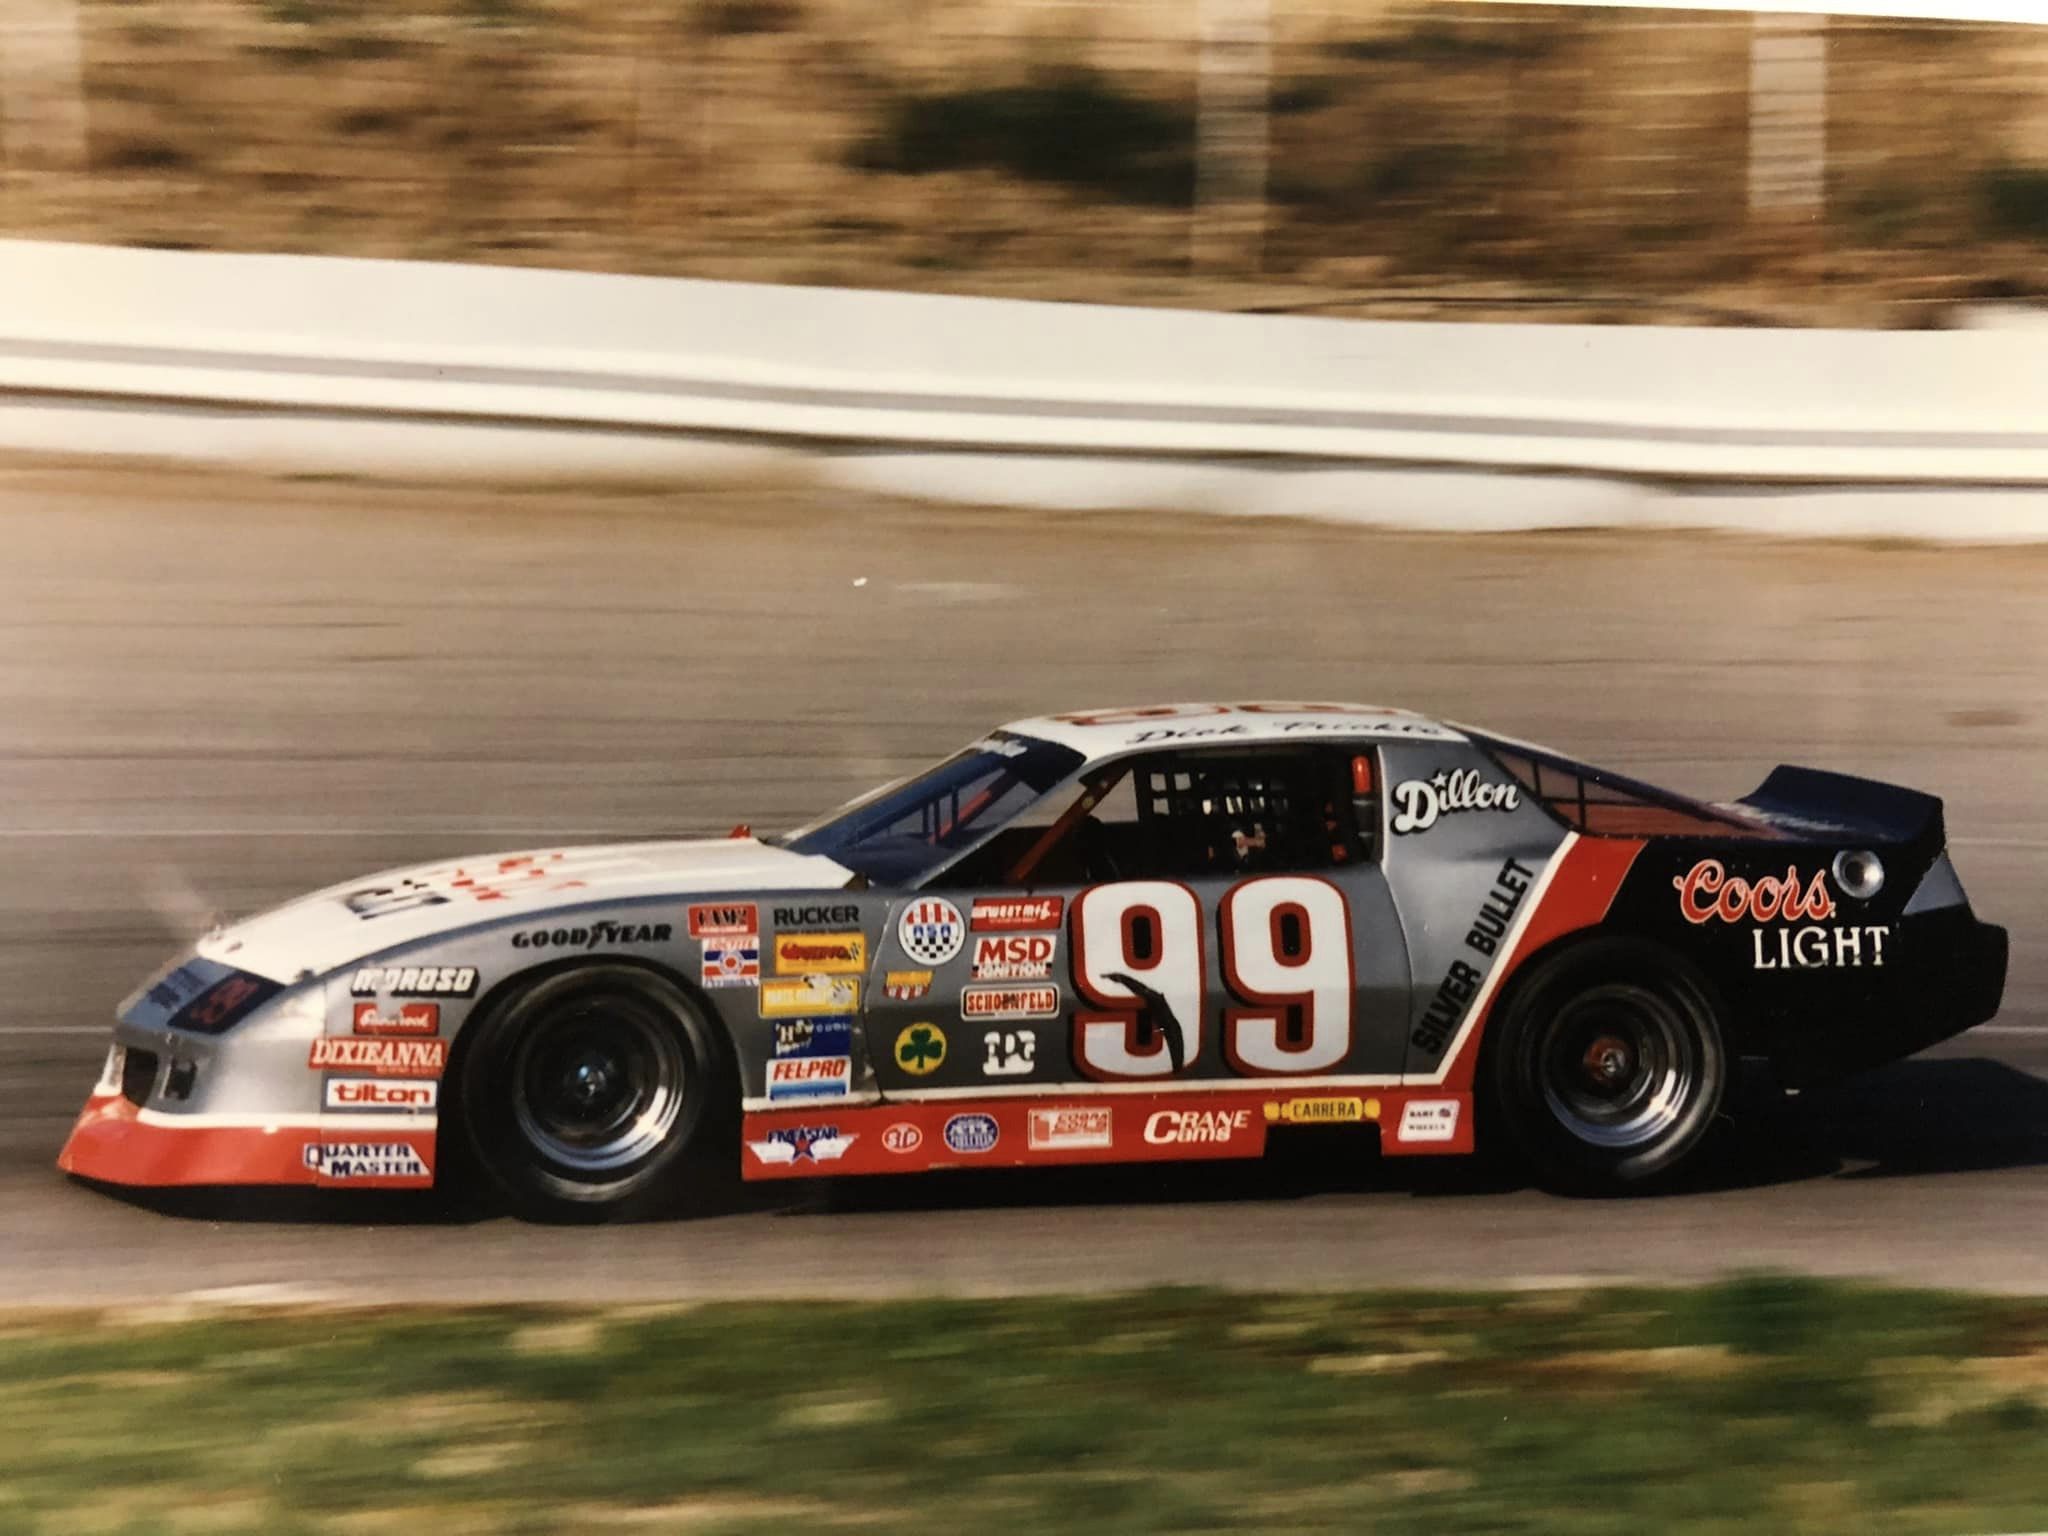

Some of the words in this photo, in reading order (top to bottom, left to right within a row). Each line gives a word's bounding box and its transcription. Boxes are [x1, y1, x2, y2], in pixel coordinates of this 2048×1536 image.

[1392, 767, 1521, 834] Dillon
[1673, 858, 1836, 924] Coors
[774, 905, 860, 926] RUCKER
[511, 920, 673, 950] GOODYEAR
[1752, 925, 1890, 969] LIGHT
[978, 937, 1053, 964] MSD
[1411, 959, 1481, 1055] SILVER
[1465, 857, 1534, 957] BULLET
[1070, 874, 1353, 1079] 99
[334, 1083, 431, 1103] tilton
[1293, 1102, 1357, 1118] CARRERA
[886, 1127, 917, 1149] STP
[304, 1143, 411, 1167] QUARTER
[330, 1160, 421, 1177] MASTER
